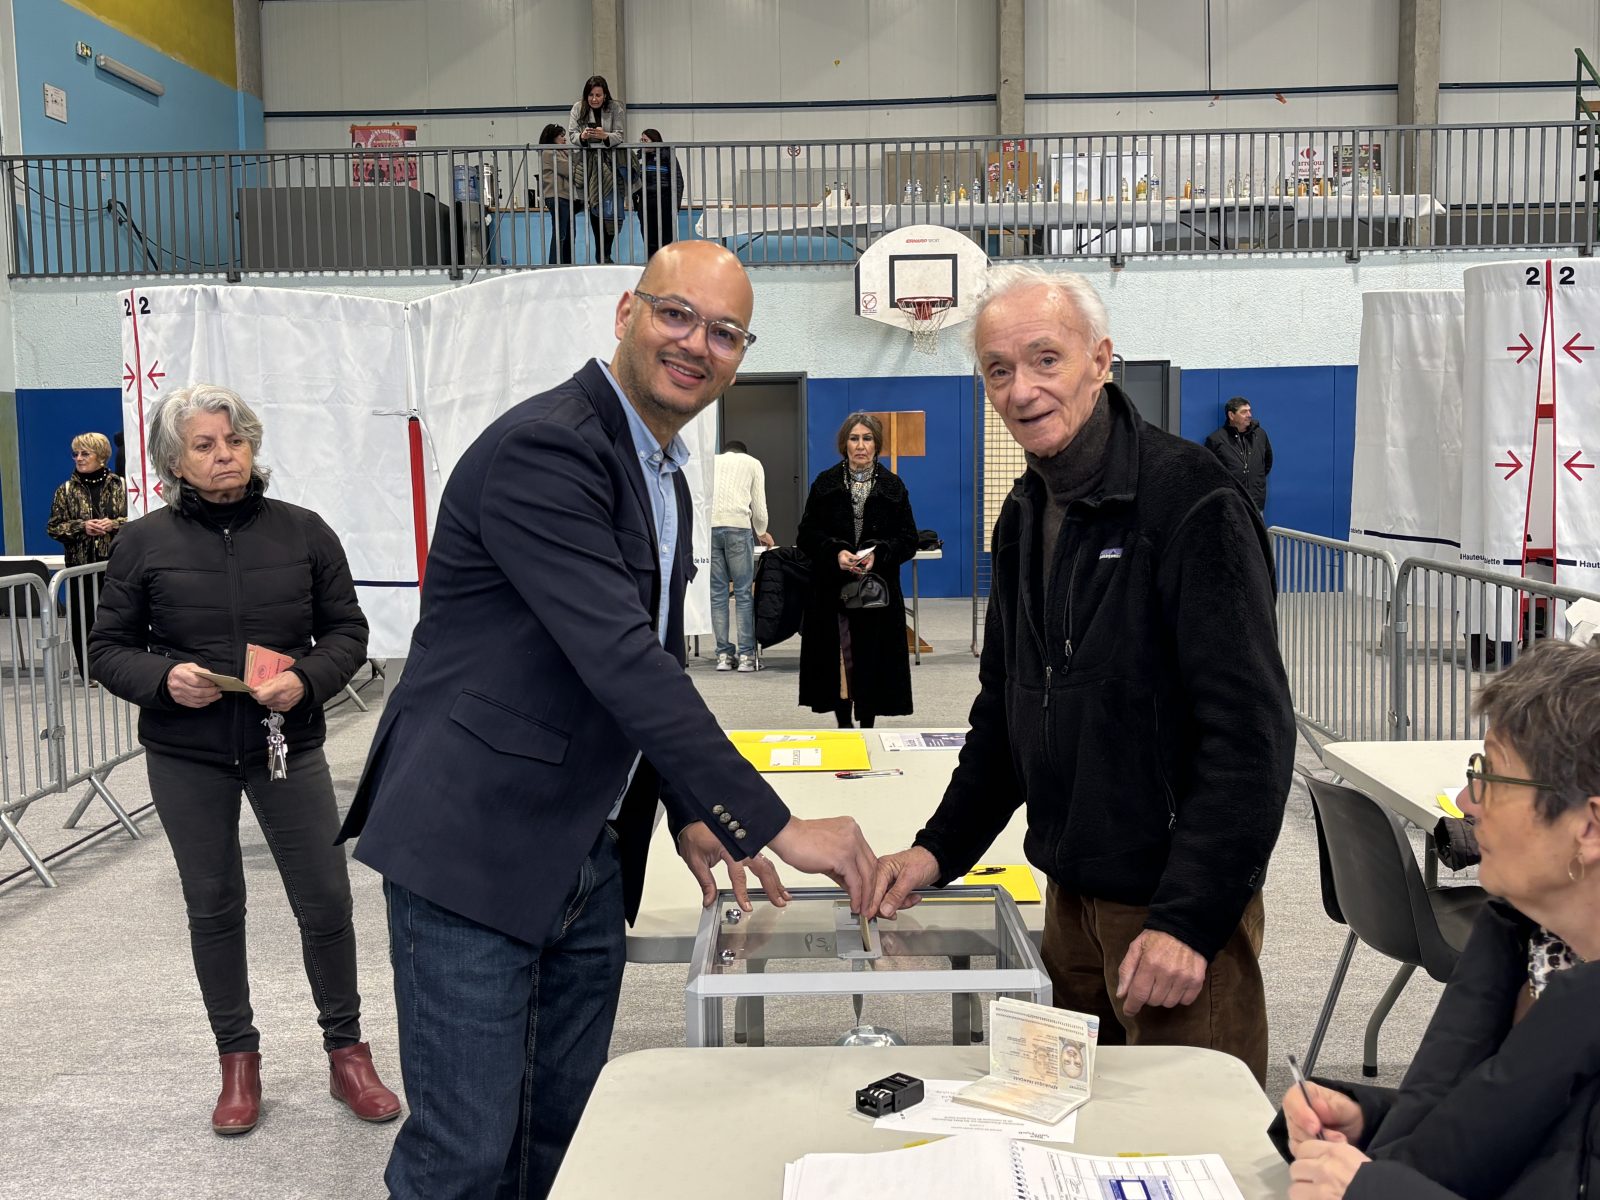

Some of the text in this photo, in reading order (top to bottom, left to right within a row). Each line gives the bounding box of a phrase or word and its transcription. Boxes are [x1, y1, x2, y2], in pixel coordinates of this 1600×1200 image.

[1525, 266, 1541, 285] 2
[1559, 266, 1576, 285] 2
[124, 298, 132, 316] 2
[139, 296, 151, 315] 2
